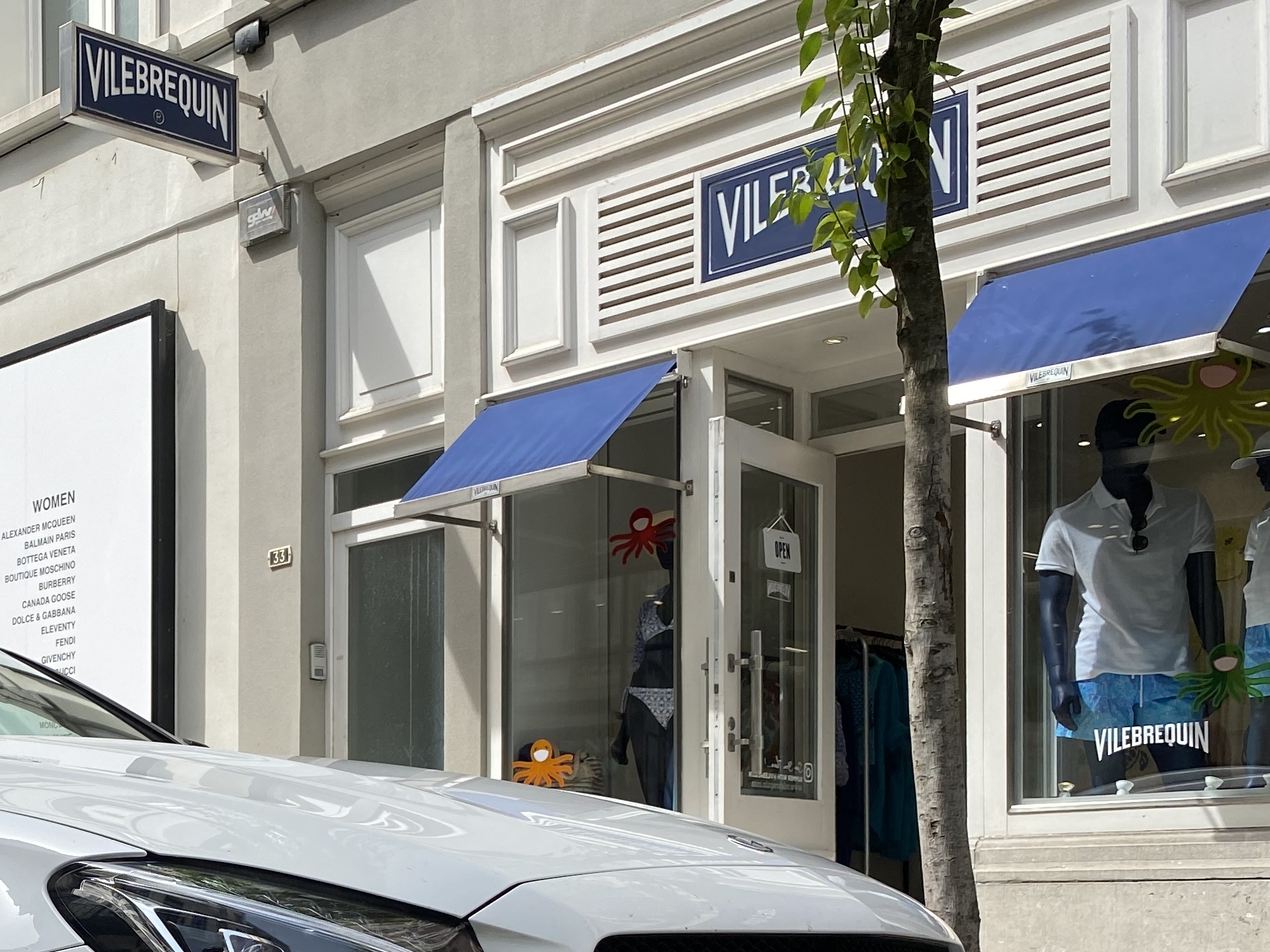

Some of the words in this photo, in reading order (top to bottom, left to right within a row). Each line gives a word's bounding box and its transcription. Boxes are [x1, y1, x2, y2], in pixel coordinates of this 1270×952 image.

[85, 42, 228, 142] VILEBREQUIN
[32, 490, 76, 513] WOMEN
[1, 523, 41, 540] ALEXANDER
[41, 515, 76, 531] MCQUEEN
[24, 536, 55, 550] BALMAIN
[55, 530, 76, 542] PARIS
[774, 540, 791, 560] OPEN
[16, 552, 49, 567] BOTTEGA
[49, 545, 76, 559] VENETA
[273, 549, 286, 564] 33
[4, 568, 38, 583] BOUTIQUE
[39, 560, 76, 576] MOSCHINO
[38, 575, 76, 591] BURBERRY
[21, 596, 50, 609] CANADA
[51, 590, 76, 604] GOOSE
[11, 613, 35, 626] DOLCE
[35, 612, 41, 621] &
[41, 606, 76, 620] GABBANA
[41, 621, 76, 635] ELEVENTY
[55, 636, 76, 647] FENDI
[41, 651, 76, 665] GIVENCHY
[1093, 720, 1209, 761] VILEBREQUIN
